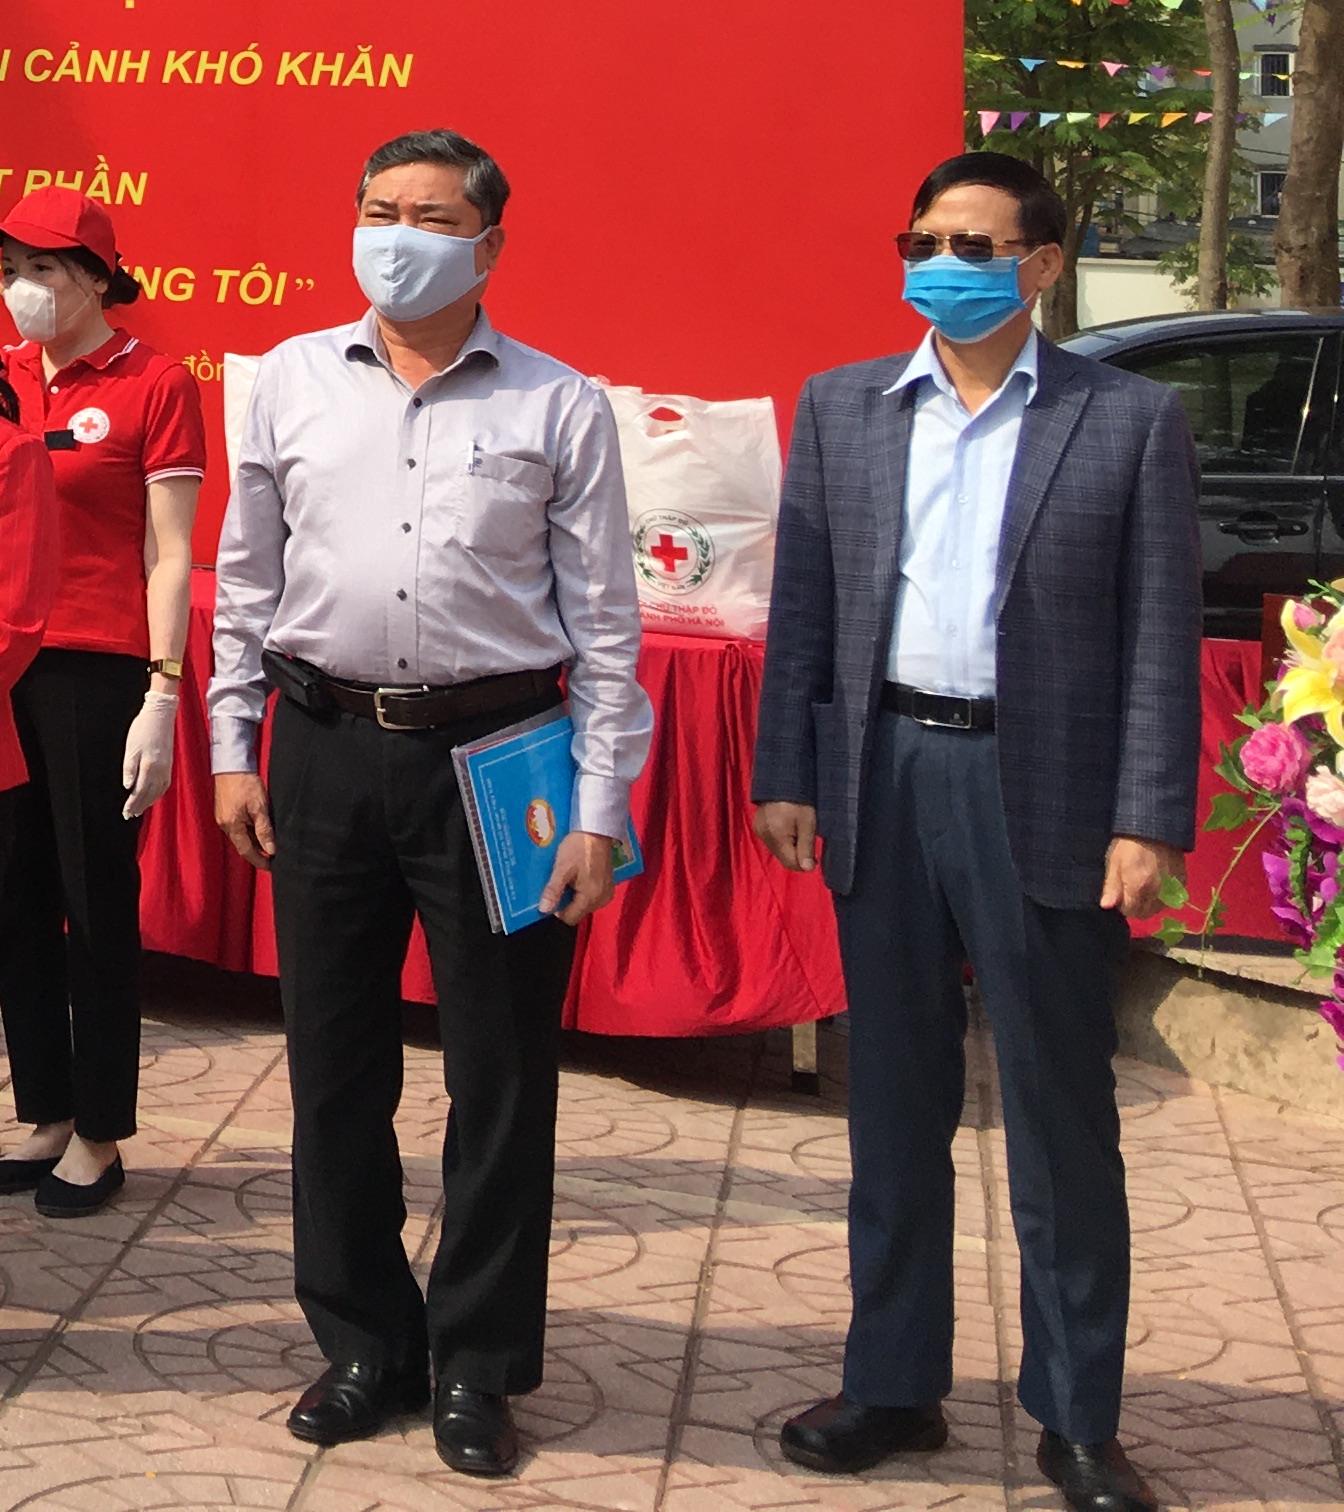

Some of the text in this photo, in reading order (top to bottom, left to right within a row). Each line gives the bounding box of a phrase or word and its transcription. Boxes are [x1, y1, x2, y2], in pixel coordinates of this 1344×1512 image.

[23, 40, 152, 84] CẢNH
[160, 41, 264, 86] KHÓ
[275, 43, 415, 89] KHĂN
